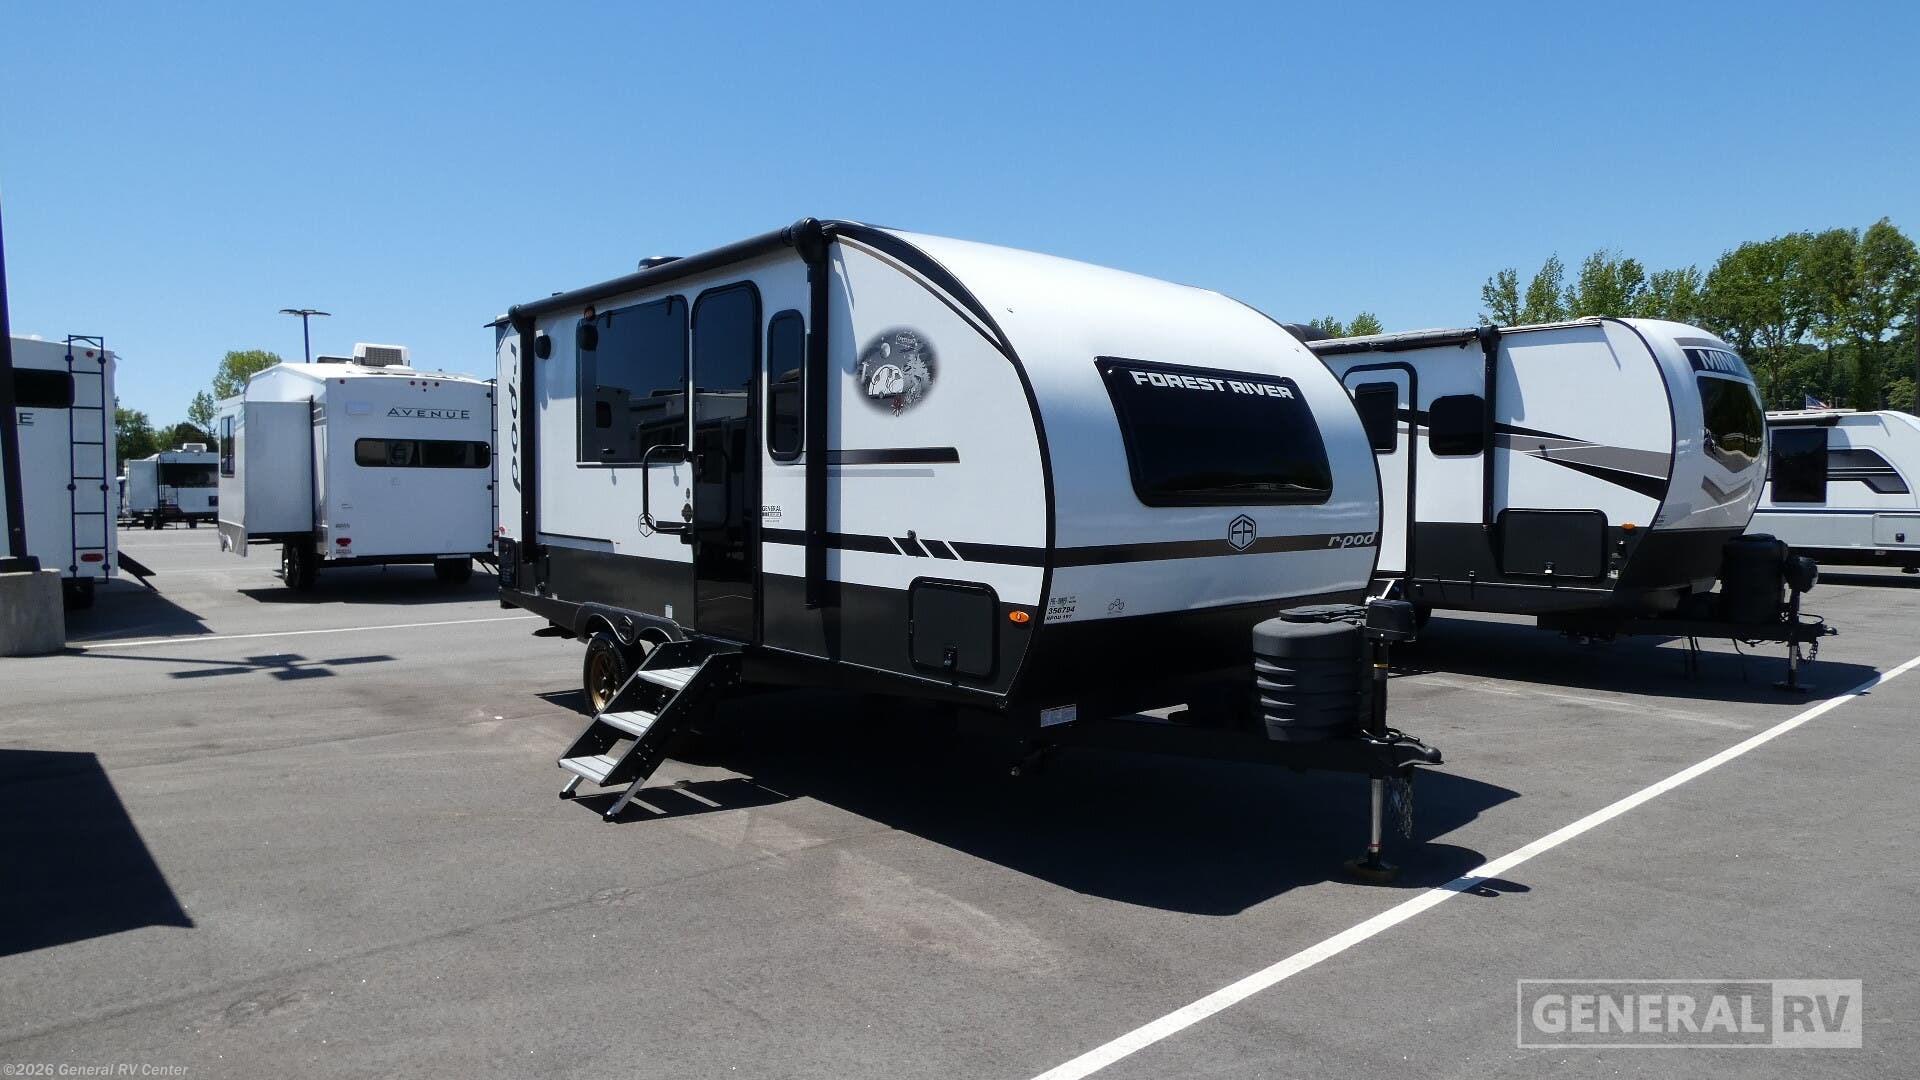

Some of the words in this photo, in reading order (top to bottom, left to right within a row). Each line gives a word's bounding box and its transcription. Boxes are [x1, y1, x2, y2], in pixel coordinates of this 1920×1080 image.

[1129, 370, 1226, 392] FOREST
[1227, 380, 1295, 400] RIVER
[386, 407, 470, 420] AVENUE
